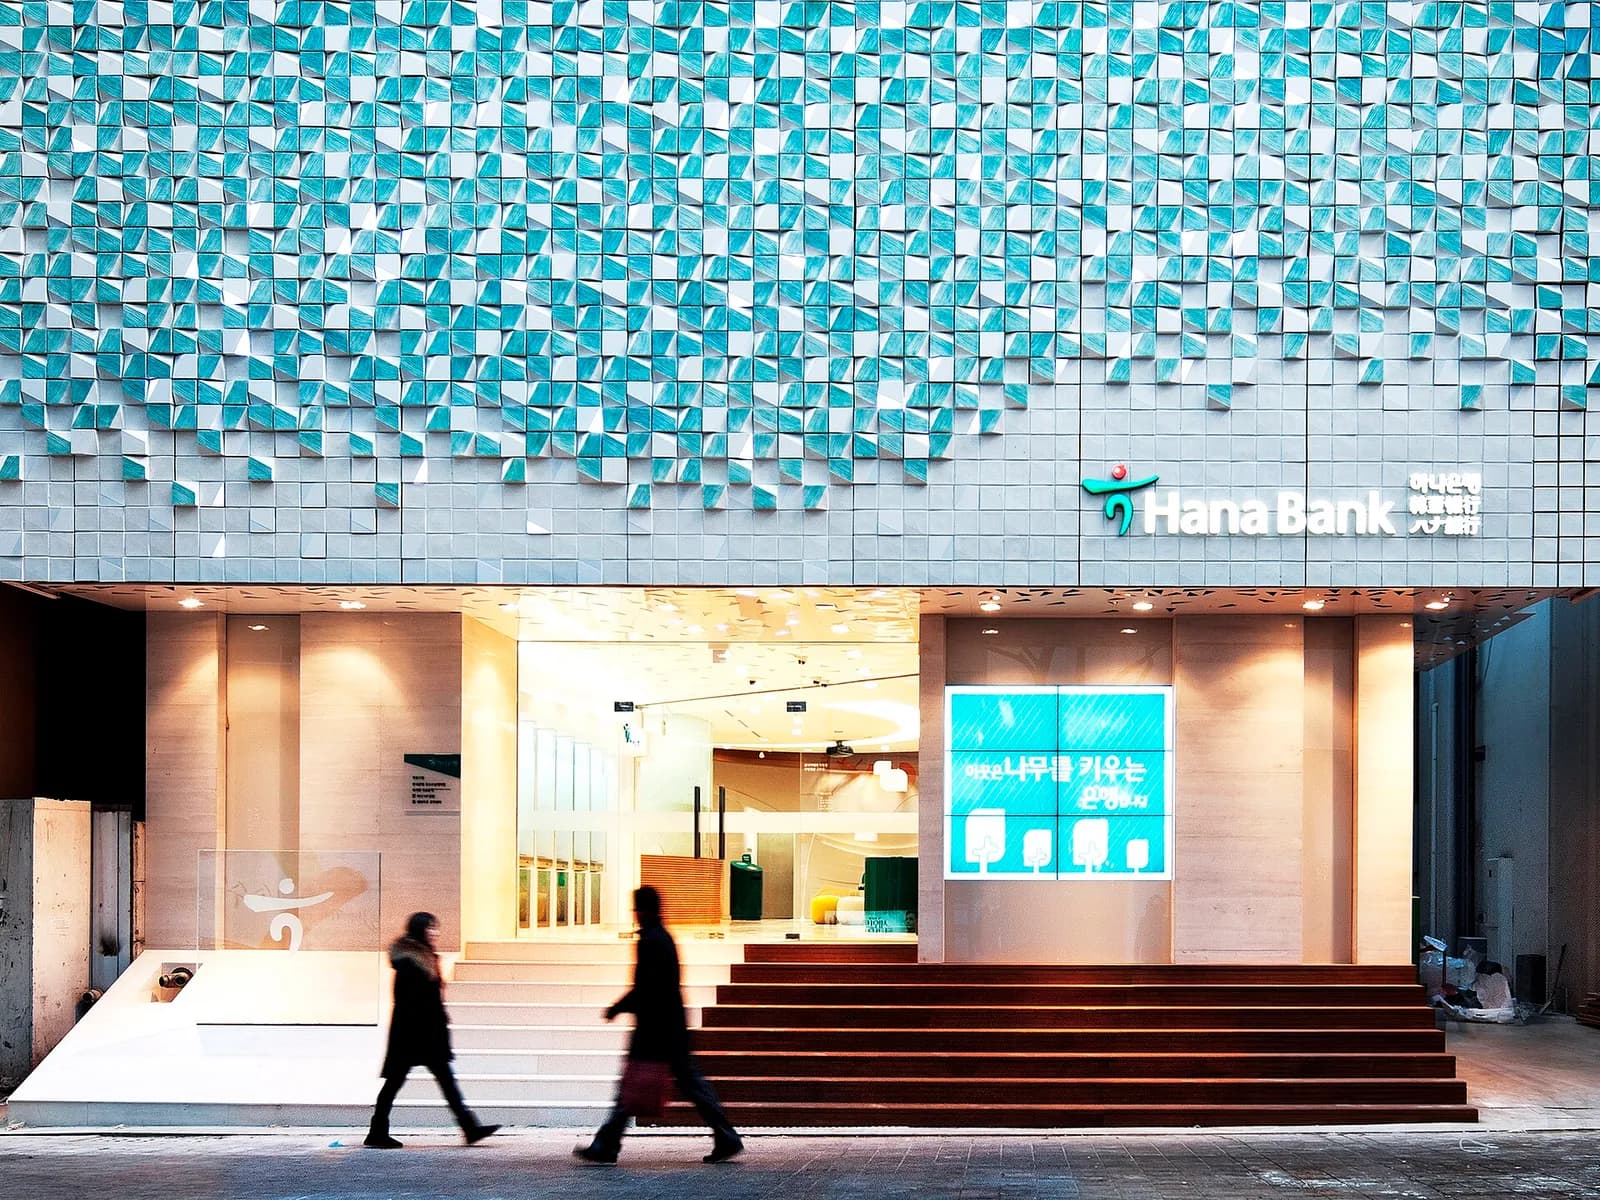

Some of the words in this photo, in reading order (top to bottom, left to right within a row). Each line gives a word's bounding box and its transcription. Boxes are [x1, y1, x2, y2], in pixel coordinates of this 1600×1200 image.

[1143, 491, 1269, 536] Hana
[1276, 489, 1396, 536] Bank
[1004, 755, 1074, 783] 나무를
[1079, 754, 1147, 783] 키우는
